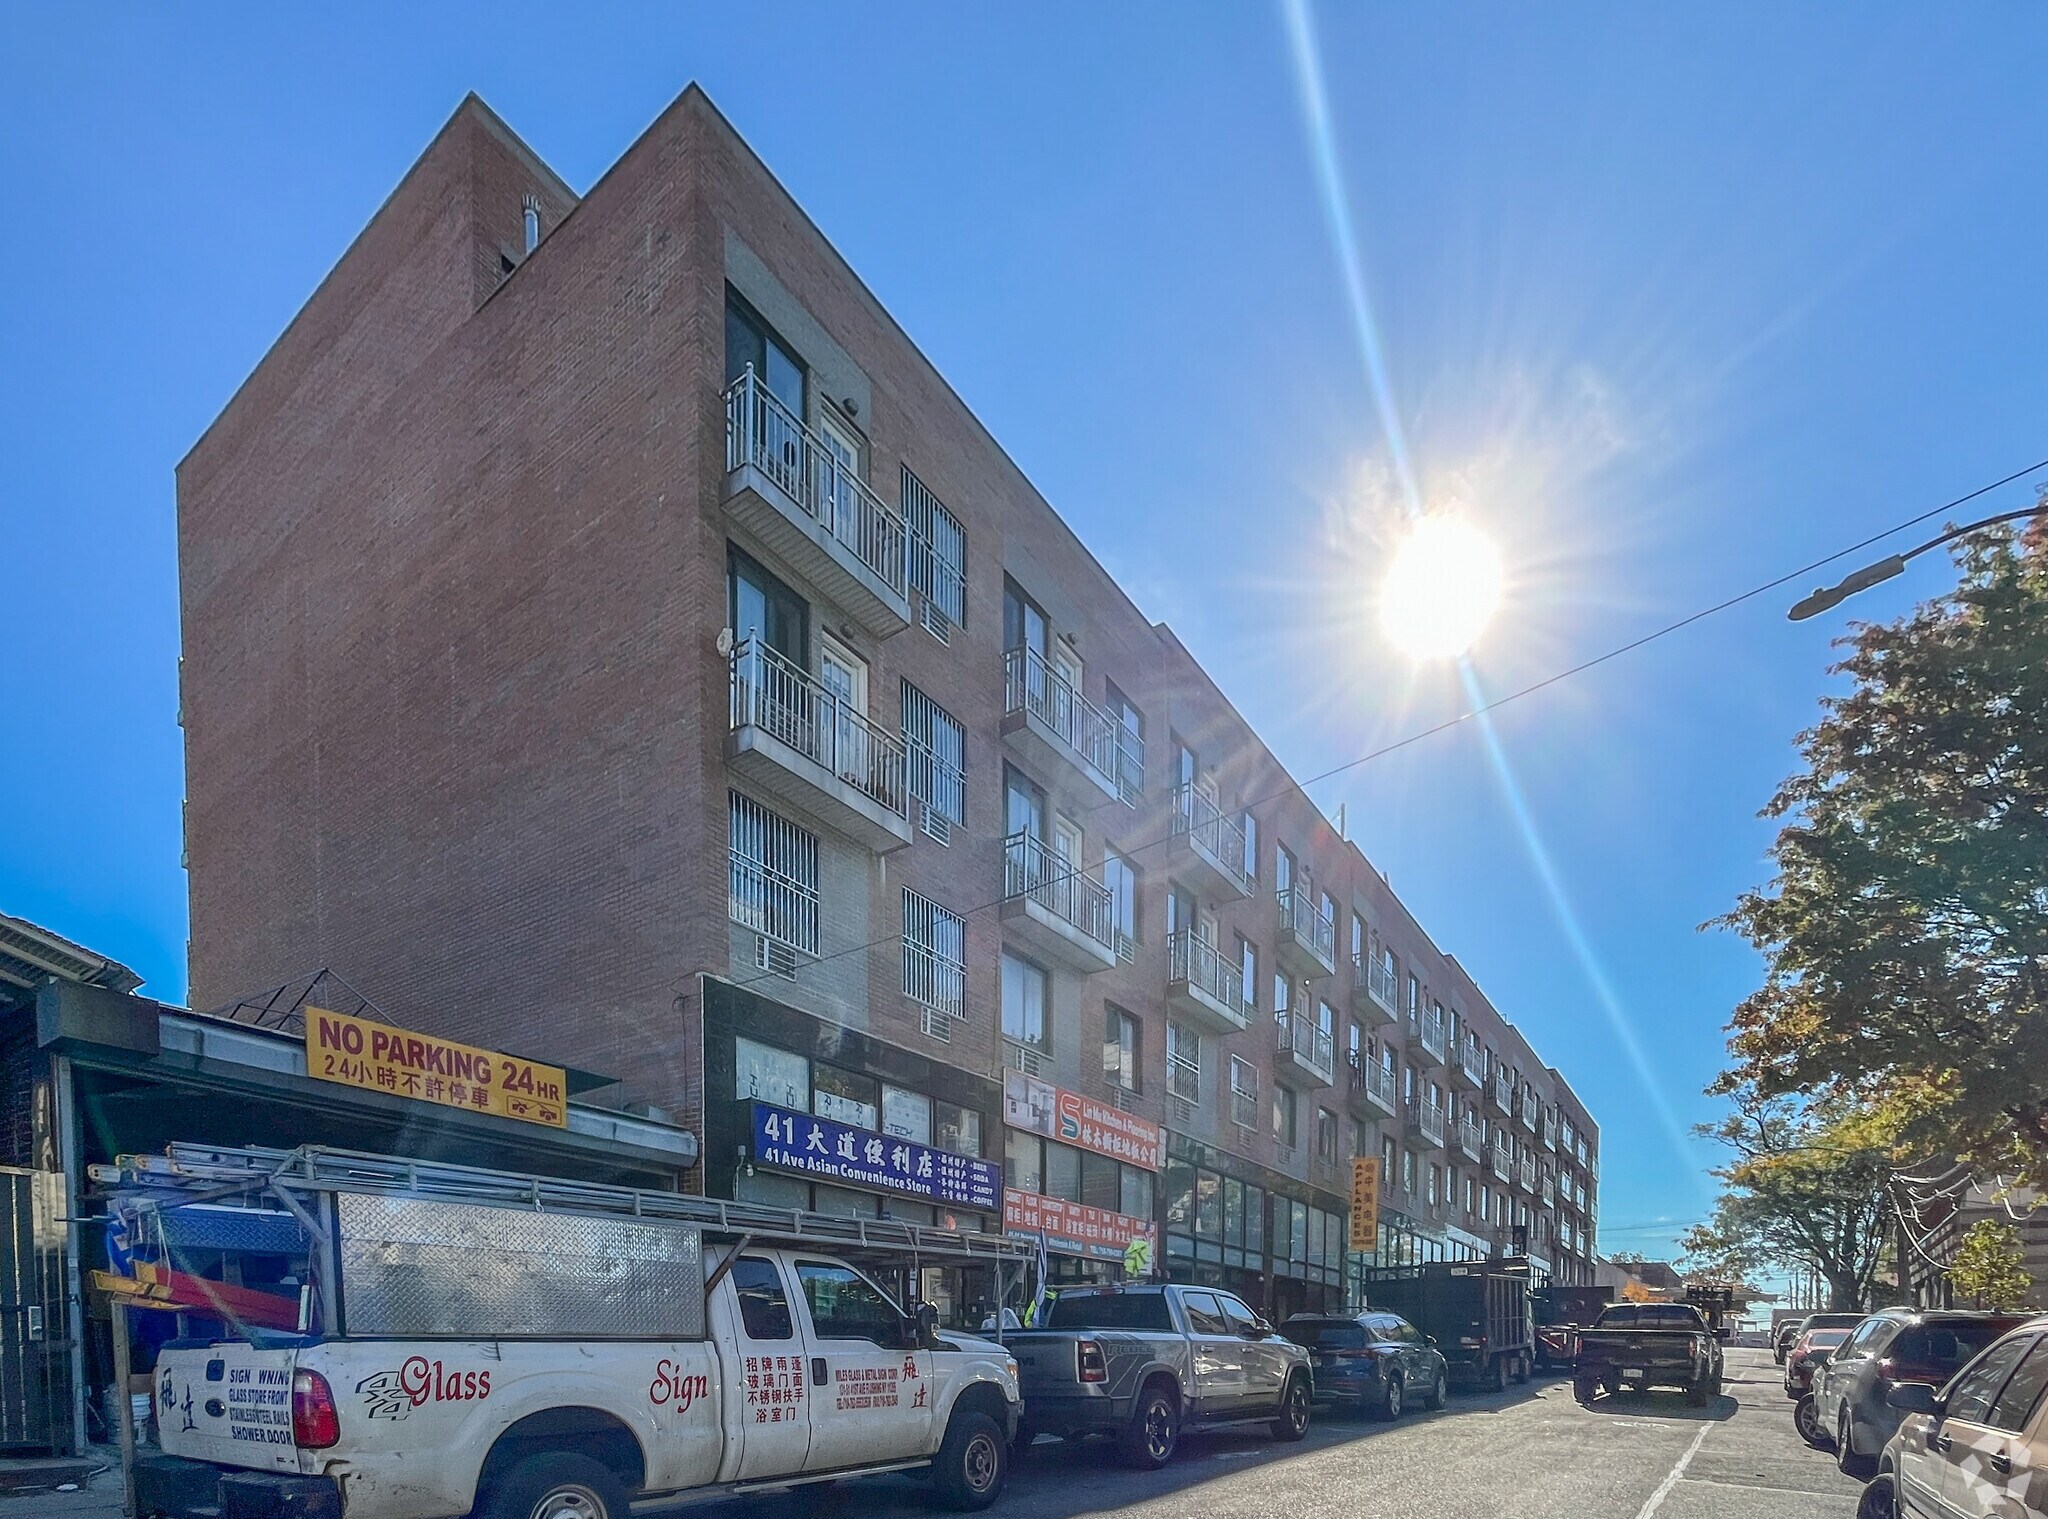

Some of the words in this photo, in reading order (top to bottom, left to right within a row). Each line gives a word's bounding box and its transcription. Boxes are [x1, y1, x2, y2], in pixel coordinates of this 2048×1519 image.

[319, 1017, 363, 1055] NO
[371, 1029, 491, 1085] PARKING
[501, 1061, 534, 1095] 24
[537, 1079, 560, 1102] HR
[765, 1147, 779, 1163] 41
[782, 1150, 804, 1169] Ave
[807, 1156, 838, 1175] Asian
[840, 1163, 905, 1189] Convenience
[907, 1177, 932, 1195] Store
[973, 1173, 989, 1183] SODA
[973, 1184, 993, 1195] CANDY
[973, 1196, 993, 1207] COFFEE
[230, 1369, 251, 1384] SIGN
[400, 1355, 491, 1407] Glass
[747, 1372, 803, 1389] 玻璃门面
[650, 1359, 708, 1414] Sign
[228, 1388, 247, 1403] GLASS
[747, 1387, 804, 1406] 不锈钢扶手
[273, 1410, 290, 1426] RAILS
[755, 1407, 796, 1424] 浴室门
[231, 1425, 267, 1443] SHOWER
[267, 1429, 293, 1445] DOOR
